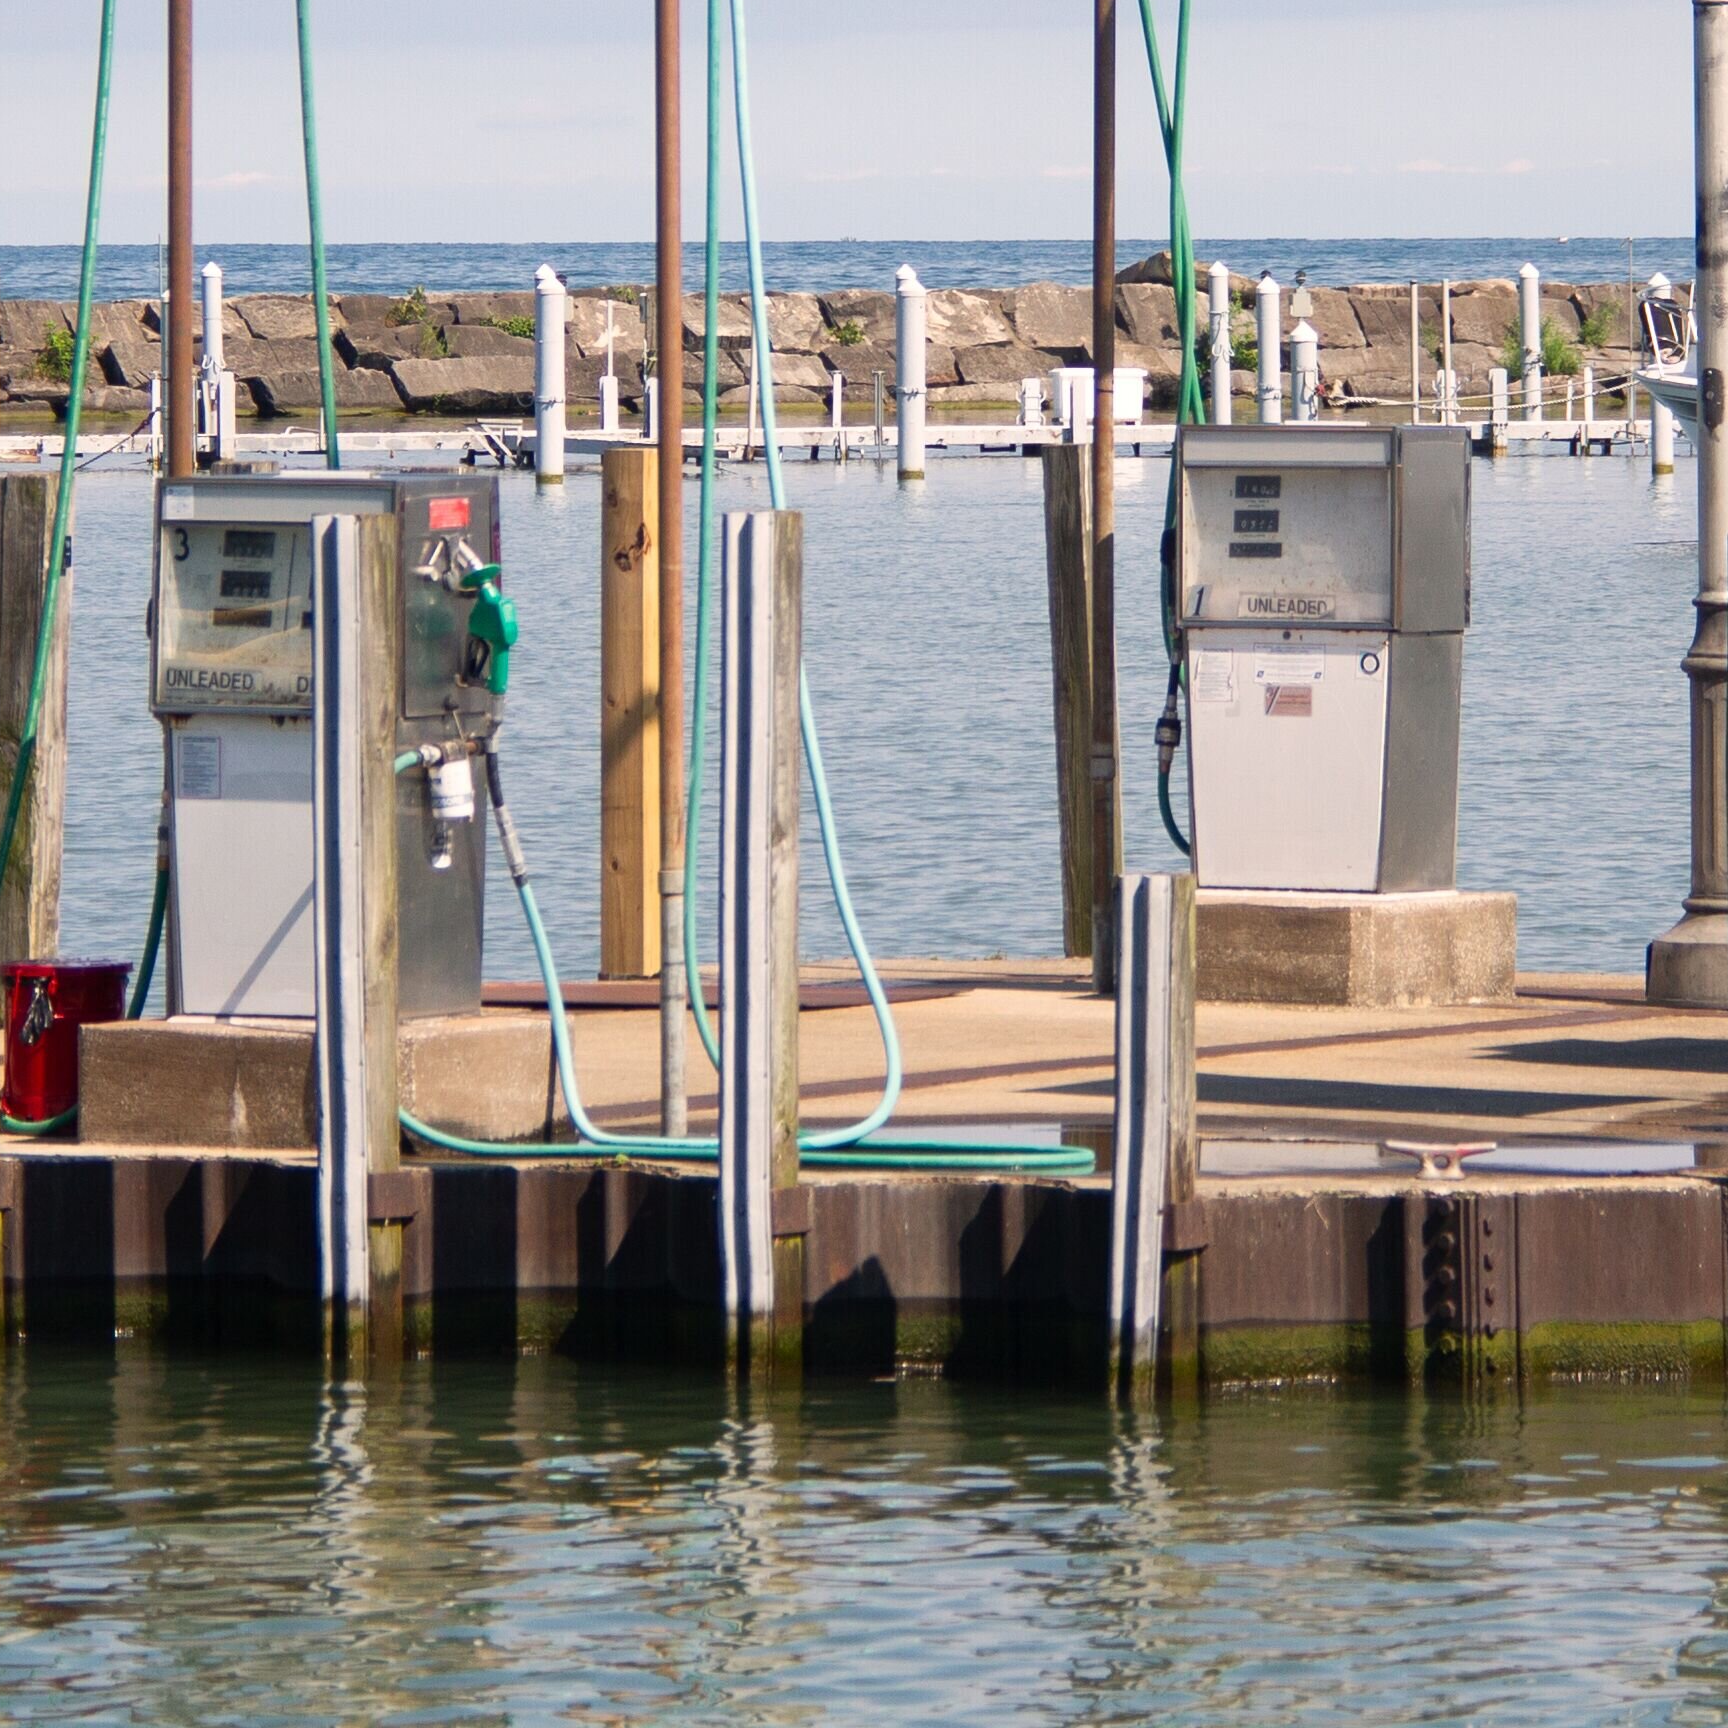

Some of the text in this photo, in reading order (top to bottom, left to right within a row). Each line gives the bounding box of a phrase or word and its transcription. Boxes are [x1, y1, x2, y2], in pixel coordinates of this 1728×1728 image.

[174, 528, 190, 561] 3
[1192, 586, 1204, 616] 1
[1248, 597, 1328, 615] UNLEADED
[166, 669, 254, 690] UNLEADED
